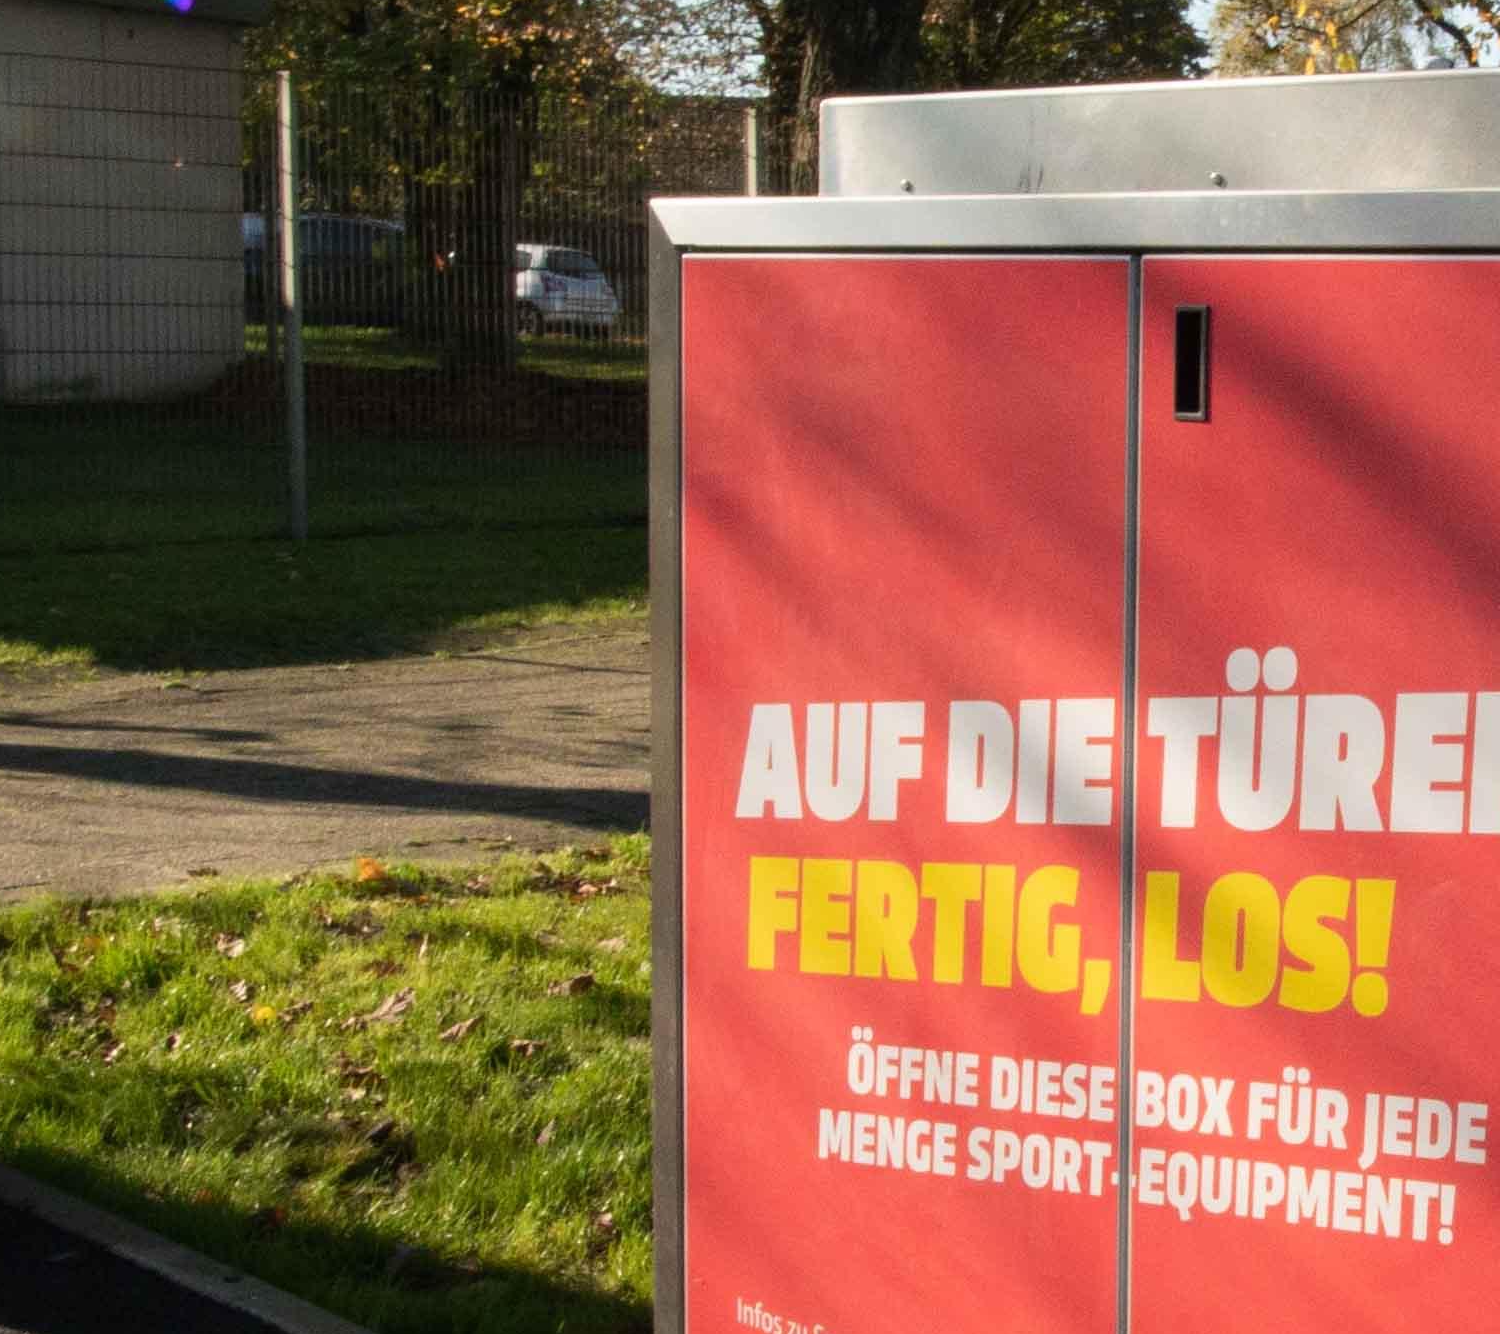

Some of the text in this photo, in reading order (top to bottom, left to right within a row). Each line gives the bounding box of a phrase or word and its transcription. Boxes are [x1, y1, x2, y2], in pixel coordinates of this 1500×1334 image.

[734, 699, 926, 823] AUF
[945, 697, 1116, 826] DIE
[747, 855, 1397, 1019] FERTIG, LOS!
[817, 1107, 957, 1176] MENGE
[847, 1025, 1490, 1170] ÖFFNE DIESE BOX FÜR JEDE
